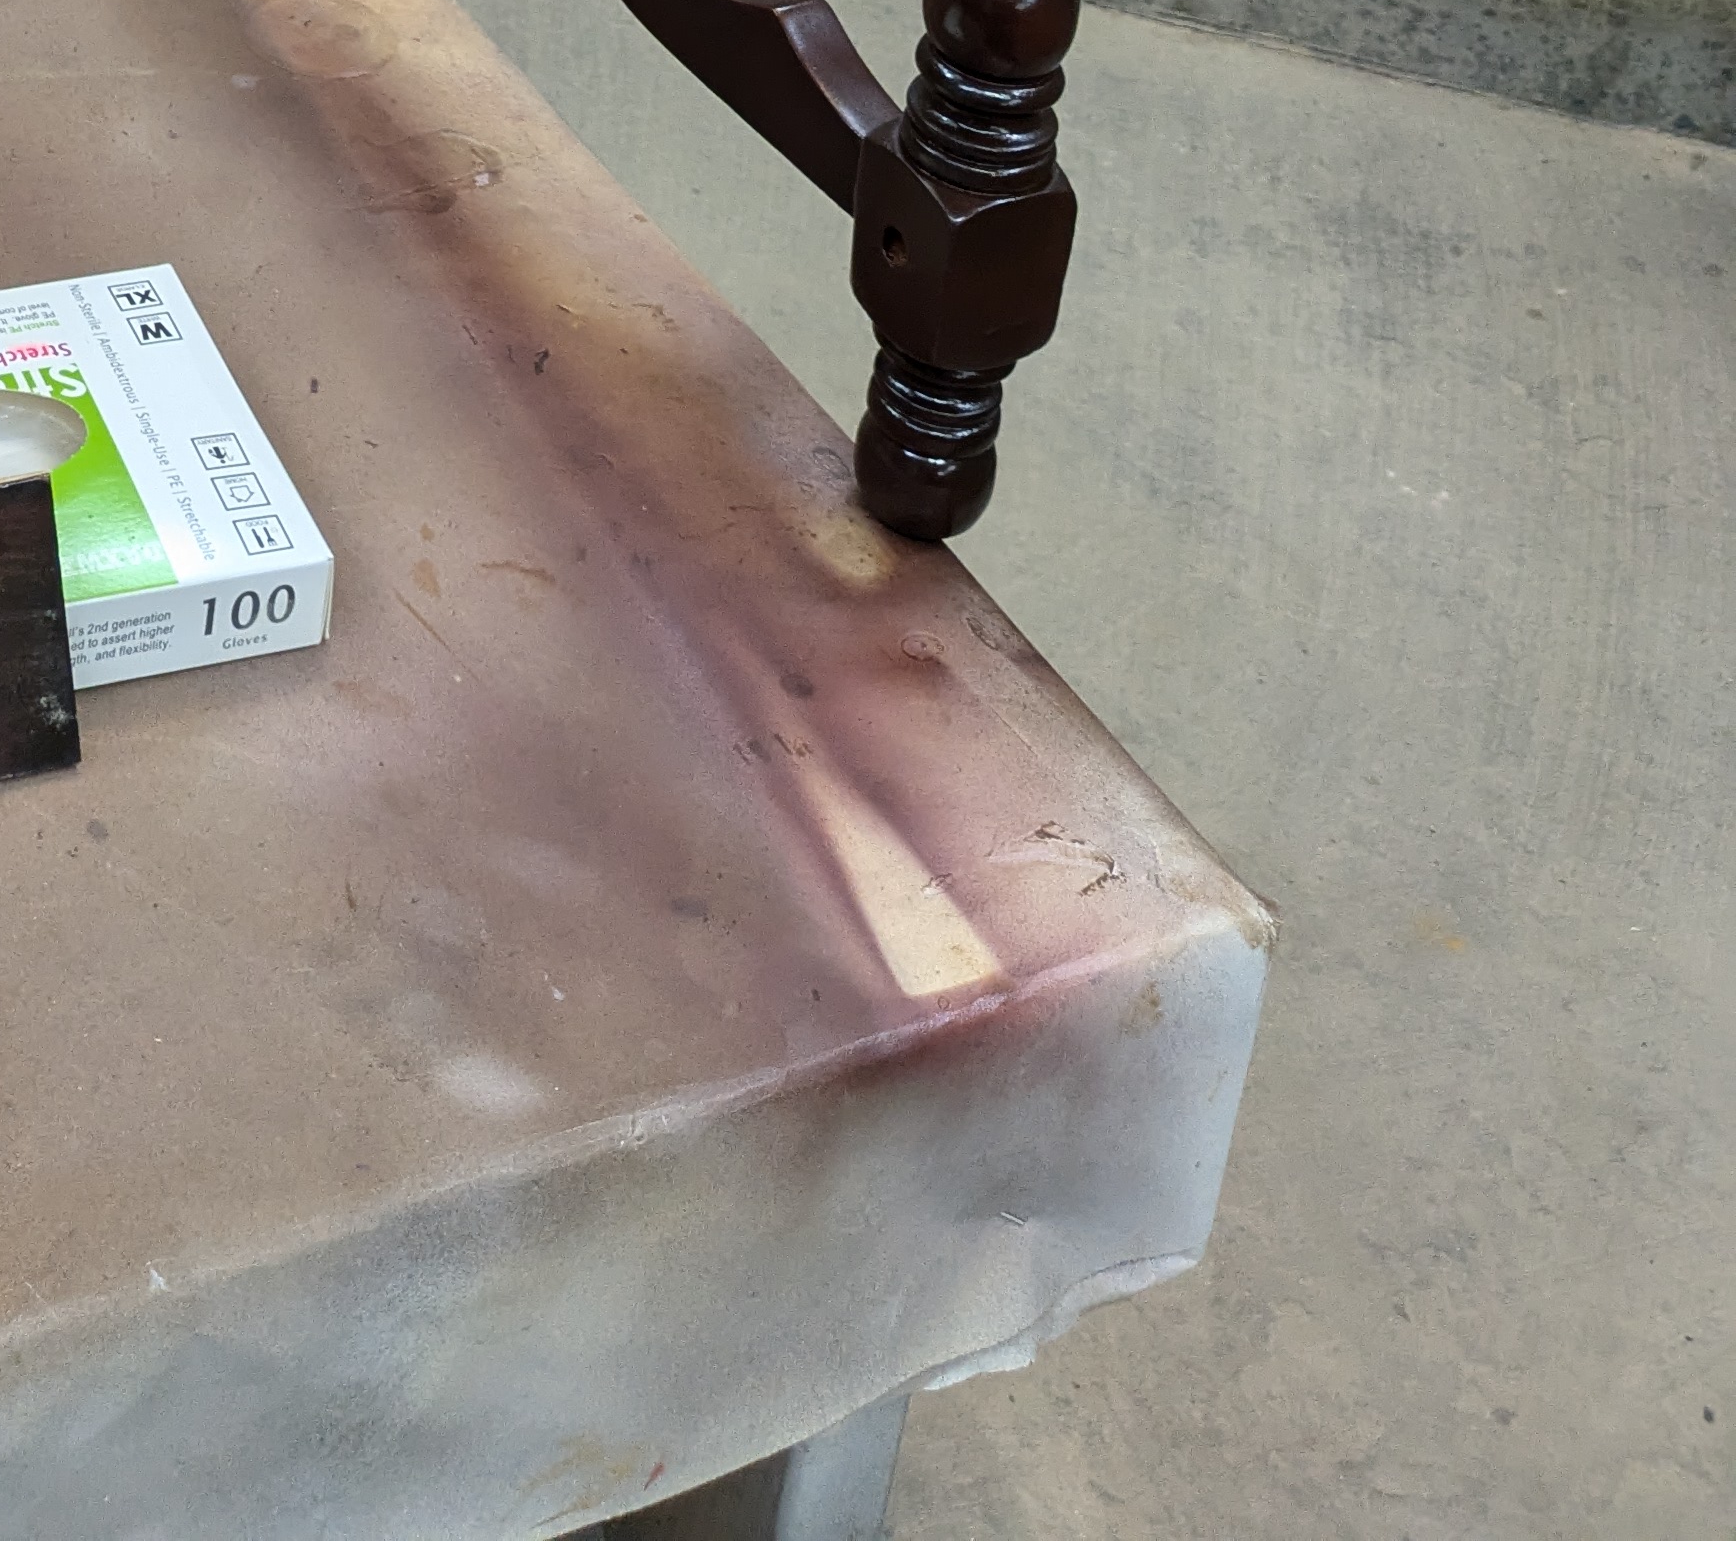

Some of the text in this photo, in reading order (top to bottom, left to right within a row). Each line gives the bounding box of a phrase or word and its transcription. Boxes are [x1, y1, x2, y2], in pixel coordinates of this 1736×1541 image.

[116, 289, 157, 306] XL
[139, 321, 173, 342] W
[69, 284, 216, 561] Non-Sterile Ambidextrous Single-Use PE Stretchable
[203, 584, 297, 637] 100
[87, 621, 109, 635] 2nd
[111, 612, 172, 633] generation
[88, 637, 99, 648] to
[101, 630, 137, 646] assert
[139, 625, 175, 640] higher
[222, 633, 269, 650] Gloves
[94, 648, 116, 661] and
